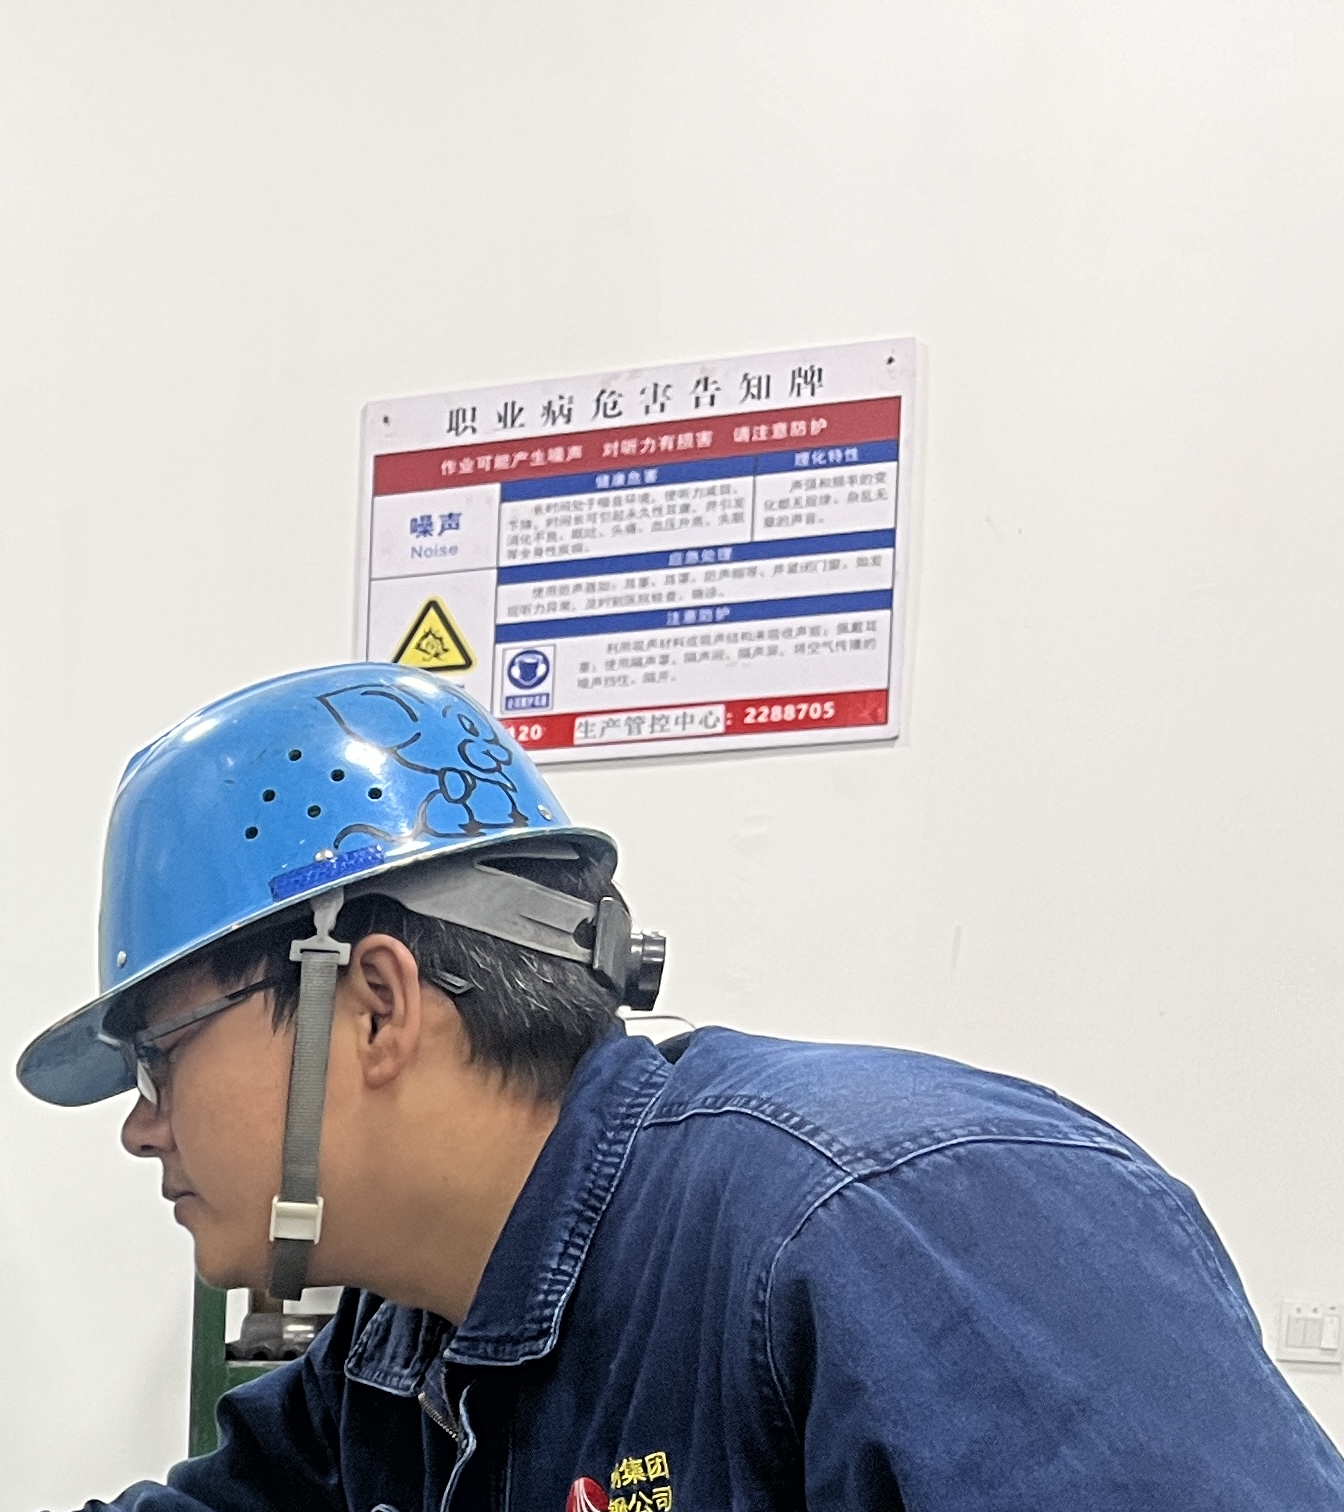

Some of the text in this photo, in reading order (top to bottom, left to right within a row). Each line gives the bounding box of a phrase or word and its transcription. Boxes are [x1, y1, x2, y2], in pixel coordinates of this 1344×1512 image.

[447, 364, 825, 437] 职业病危害告知牌
[410, 512, 462, 538] 噪声
[411, 544, 459, 560] Noise
[744, 701, 836, 725] 2288705
